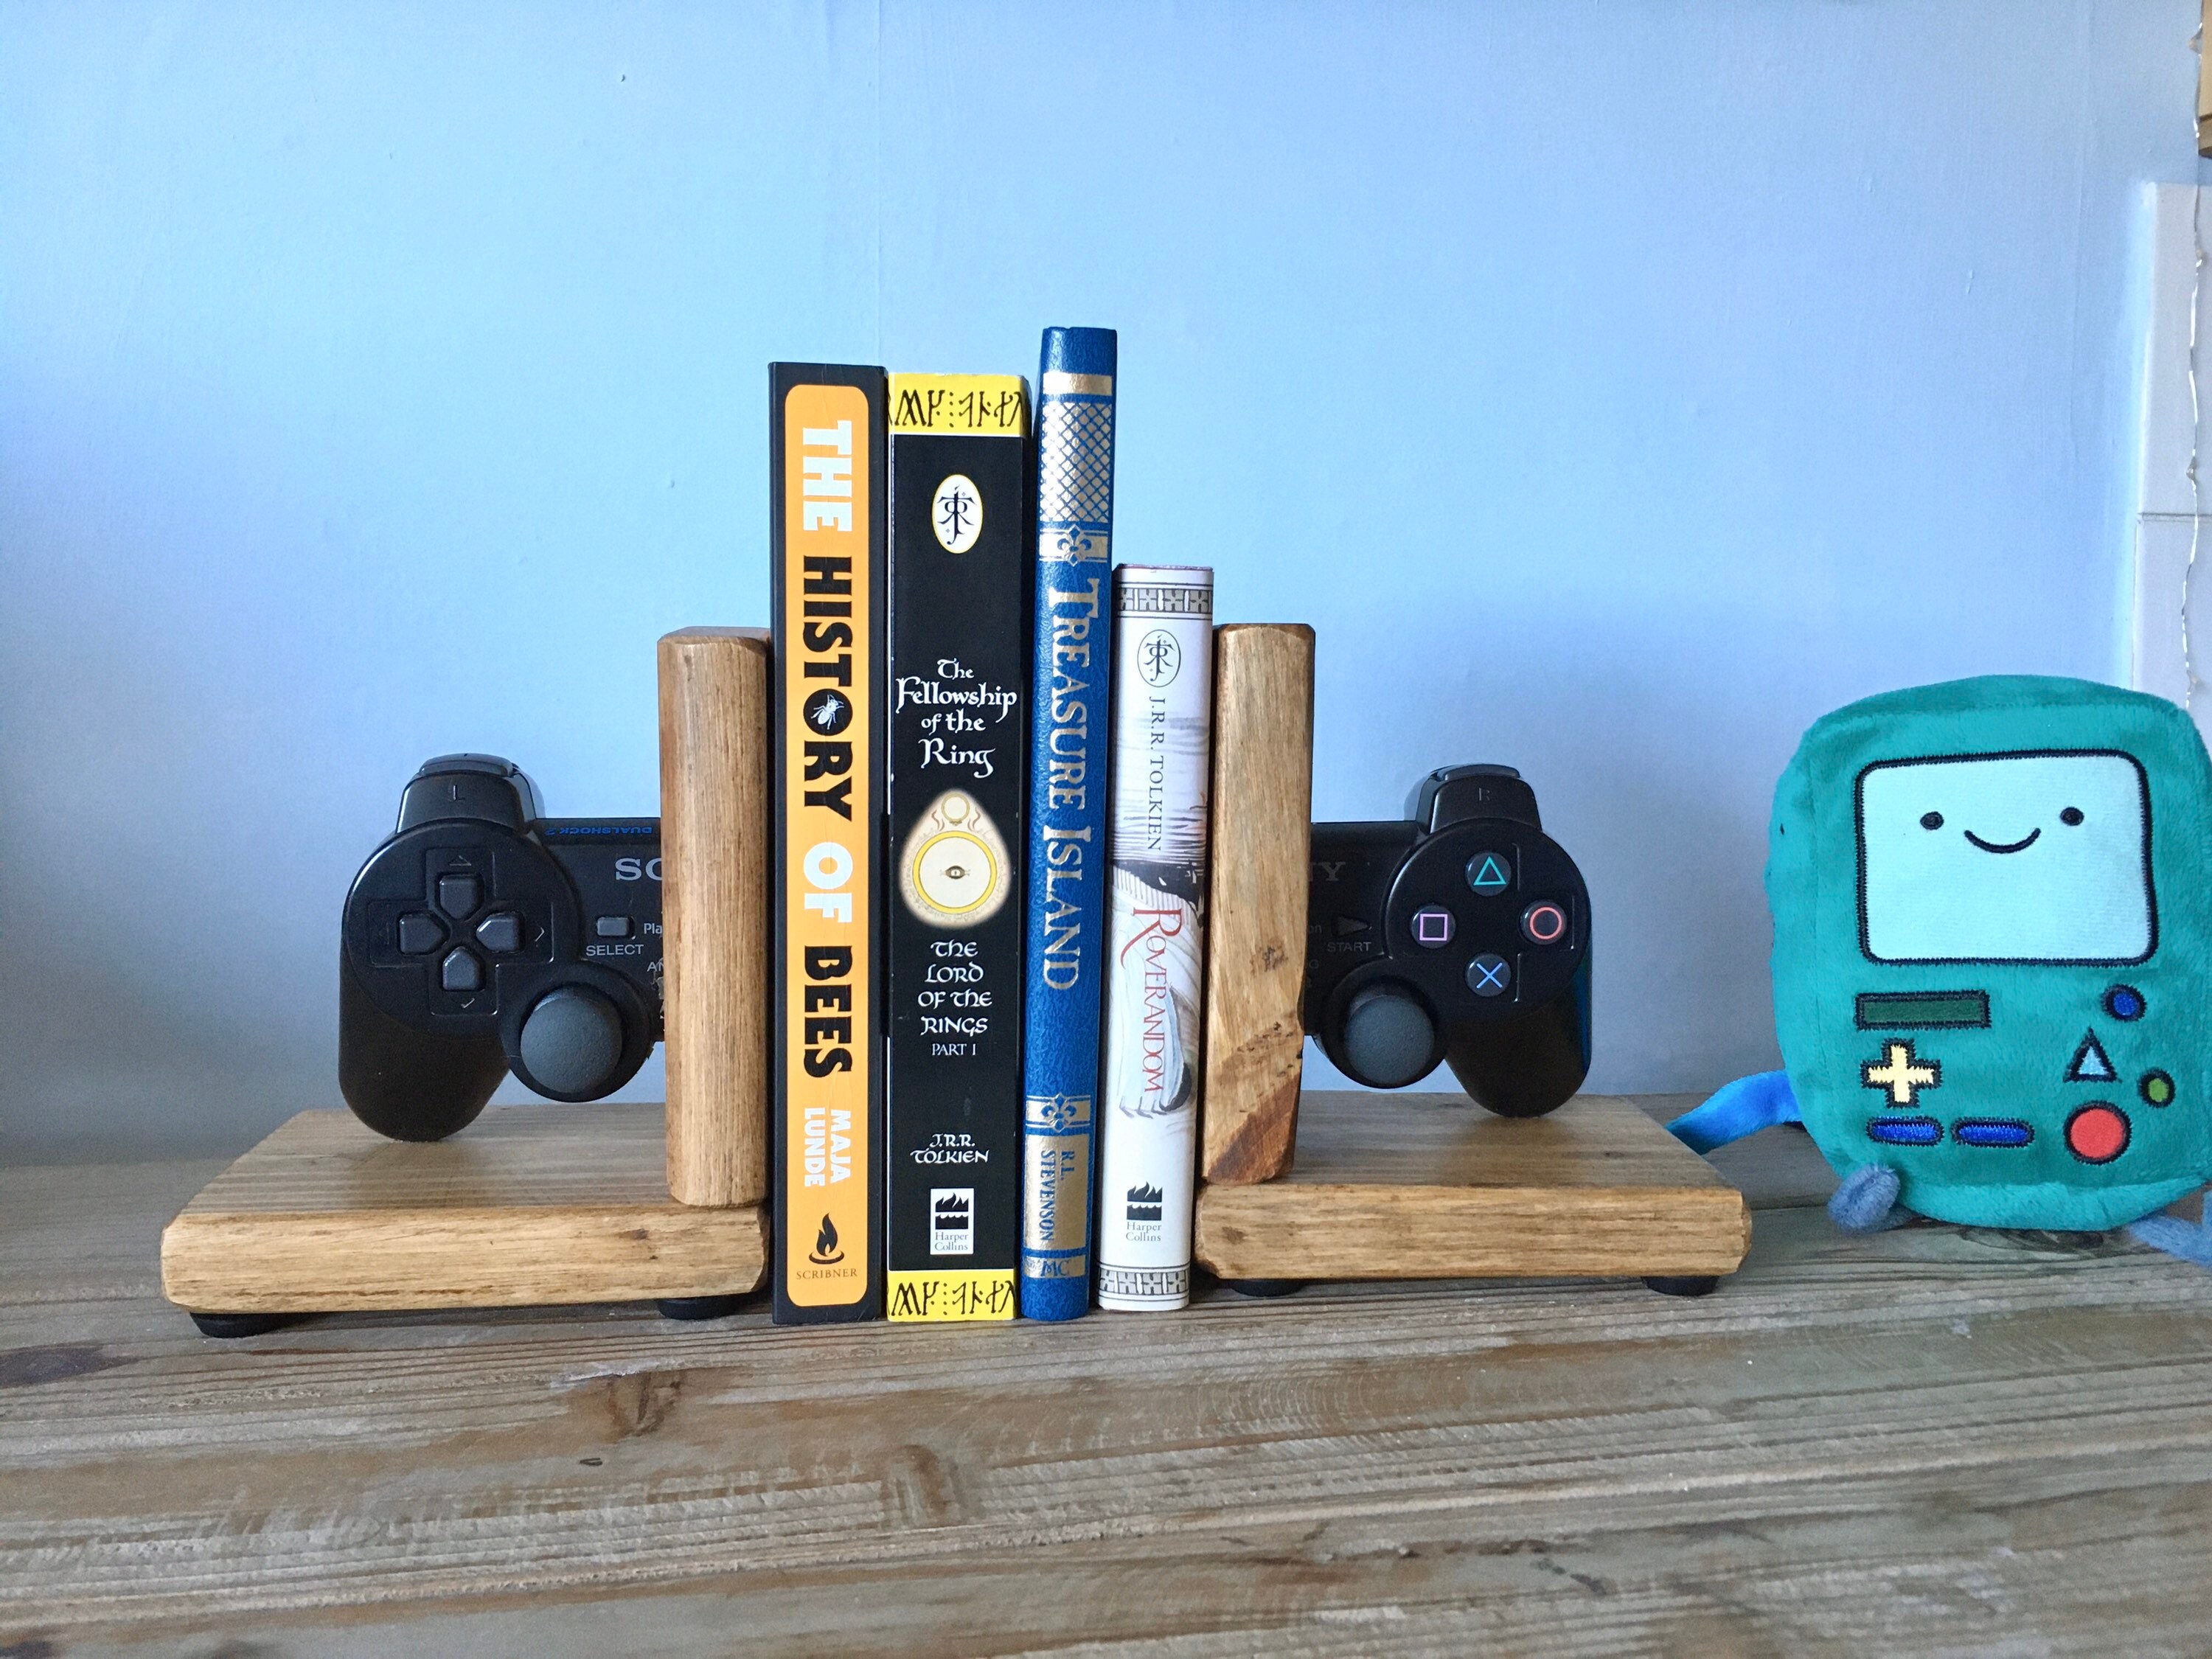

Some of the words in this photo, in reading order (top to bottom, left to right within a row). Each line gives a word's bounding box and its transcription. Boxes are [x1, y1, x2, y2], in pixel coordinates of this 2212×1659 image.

[802, 420, 853, 532] THE
[937, 658, 975, 679] The
[803, 555, 853, 821] HISTORY
[895, 675, 1018, 724] Fellowship
[1048, 578, 1099, 810] TREASURE
[921, 713, 941, 735] of
[945, 709, 987, 733] the
[919, 737, 996, 779] Ring
[1147, 756, 1165, 851] TOLKIEN
[560, 827, 653, 835] DUALSHOCK
[803, 841, 854, 923] OF
[1043, 825, 1092, 990] ISLAND
[586, 944, 644, 956] SELECT
[1327, 941, 1372, 953] START
[803, 945, 853, 1079] BEES
[920, 1015, 988, 1036] RINGS
[931, 1043, 966, 1056] PART
[804, 1107, 826, 1187] LUNDE
[830, 1108, 852, 1184] MAJA
[910, 1147, 990, 1165] TOLKIEN
[1039, 1150, 1057, 1242] STEVENSON
[935, 1231, 970, 1244] Harper
[1125, 1231, 1162, 1242] Collins
[1127, 1221, 1162, 1234] Harper
[934, 1241, 969, 1252] Collins
[796, 1267, 858, 1281] SCRIBNER
